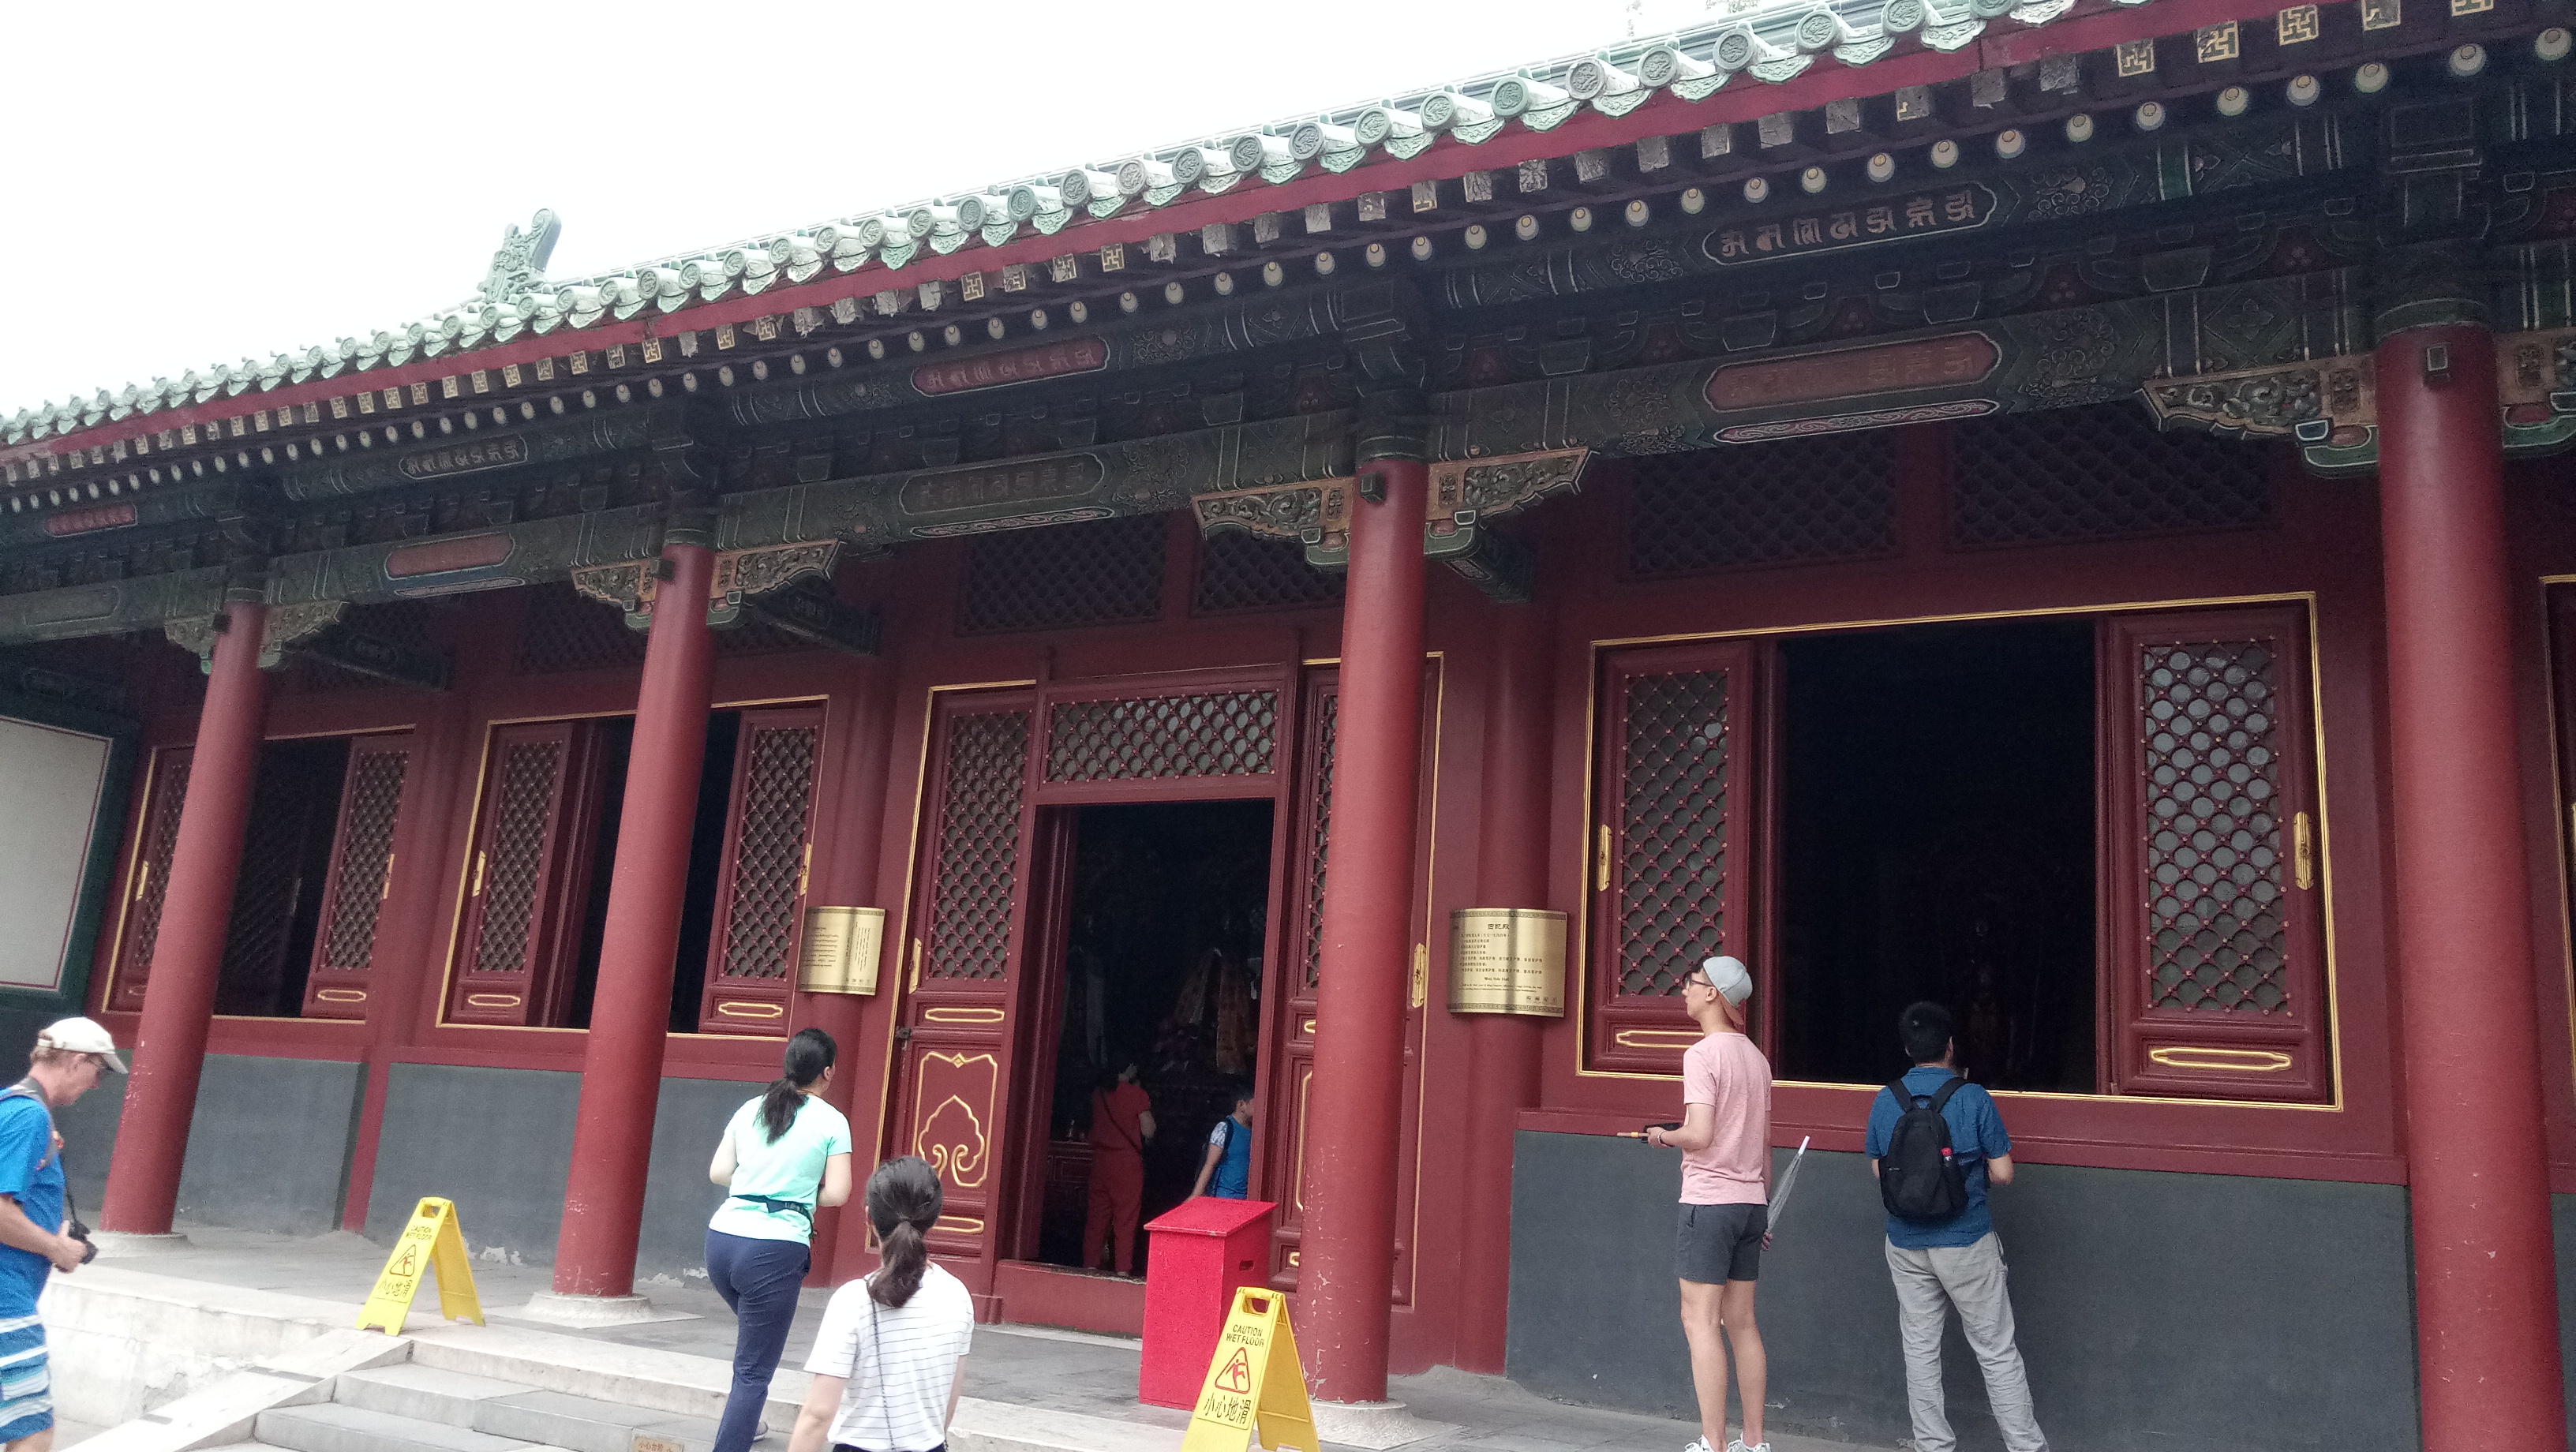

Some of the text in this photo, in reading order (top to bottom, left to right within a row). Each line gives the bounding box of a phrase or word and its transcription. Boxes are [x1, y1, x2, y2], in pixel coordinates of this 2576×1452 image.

[410, 1225, 432, 1233] CAUTION
[1233, 1324, 1264, 1337] CAUTION
[1226, 1333, 1264, 1347] WET FLOOR
[1204, 1392, 1252, 1424] 小心地滑
